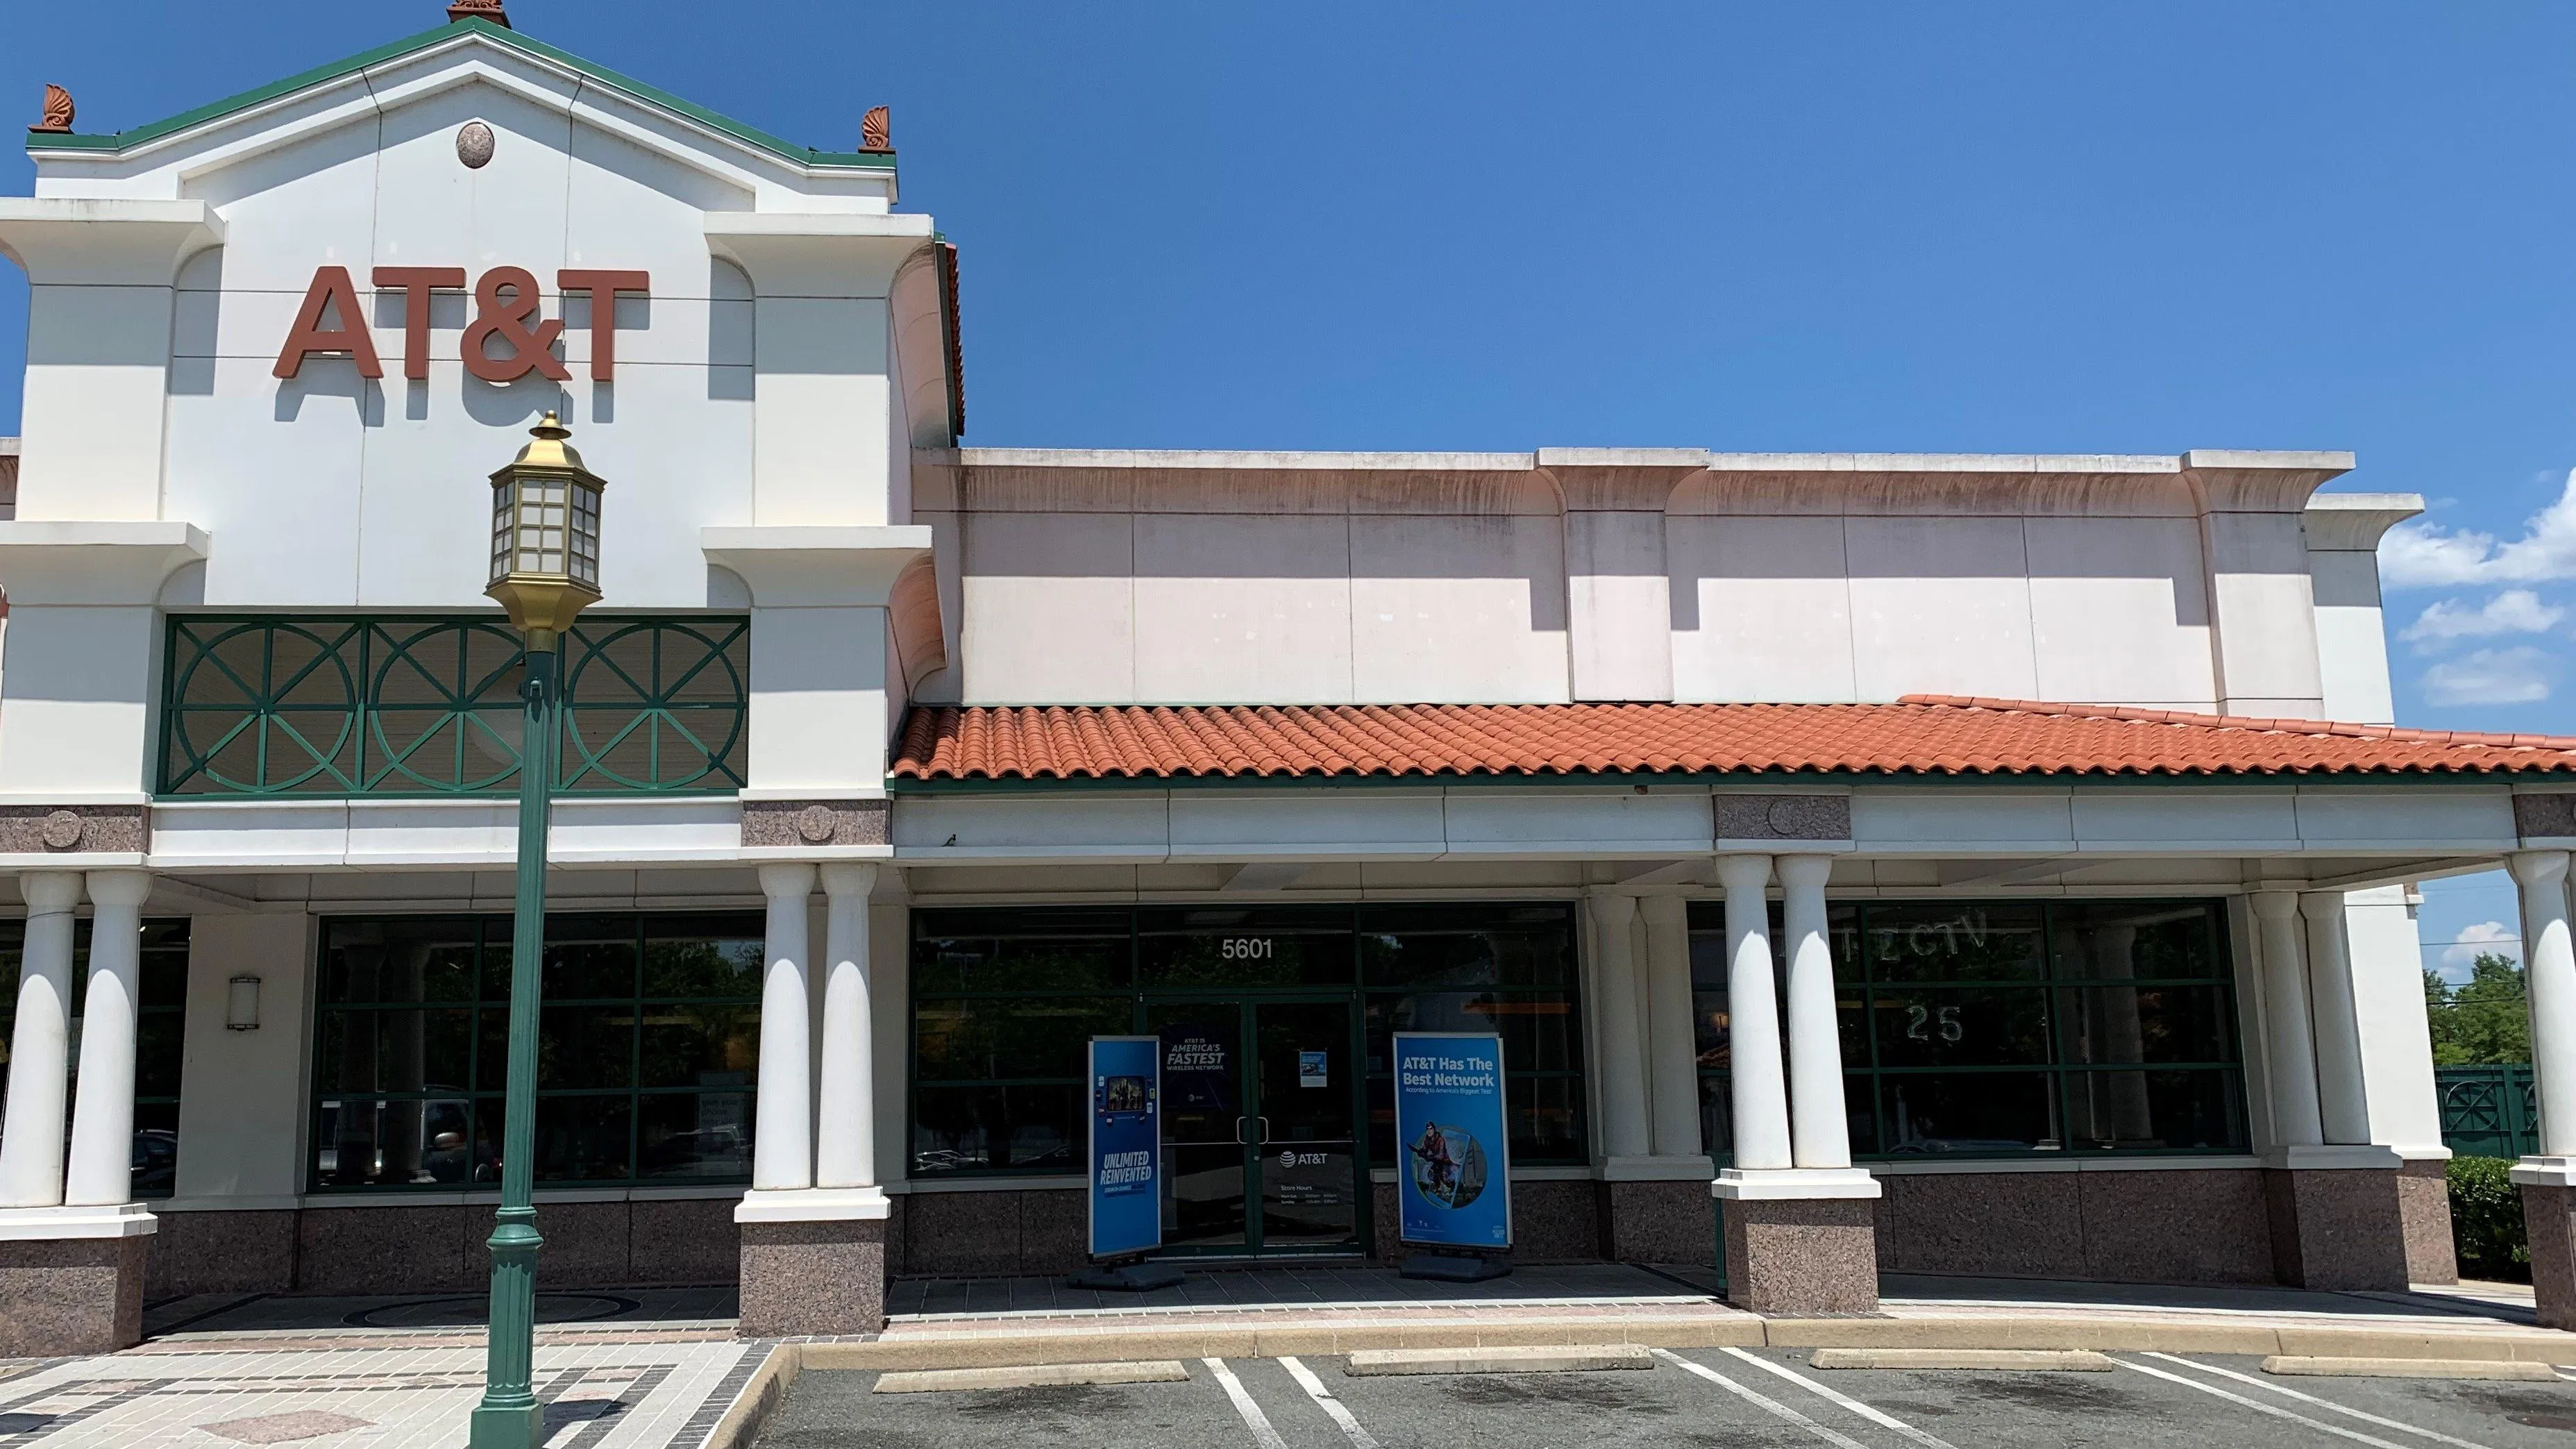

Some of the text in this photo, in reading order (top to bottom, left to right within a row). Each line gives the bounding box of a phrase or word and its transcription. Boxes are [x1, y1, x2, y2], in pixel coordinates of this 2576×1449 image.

[272, 266, 650, 382] AT&T
[1222, 938, 1272, 959] 5601
[1905, 1005, 1963, 1041] 25
[1171, 1044, 1221, 1053] AMERICA'S
[1167, 1052, 1225, 1065] FASTEST
[1403, 1057, 1494, 1071] AT&T Has The
[1403, 1072, 1495, 1087] Best Network
[1104, 1150, 1150, 1169] UNLIMITED
[1297, 1153, 1328, 1164] AT&T
[1100, 1166, 1152, 1185] REINVENTED
